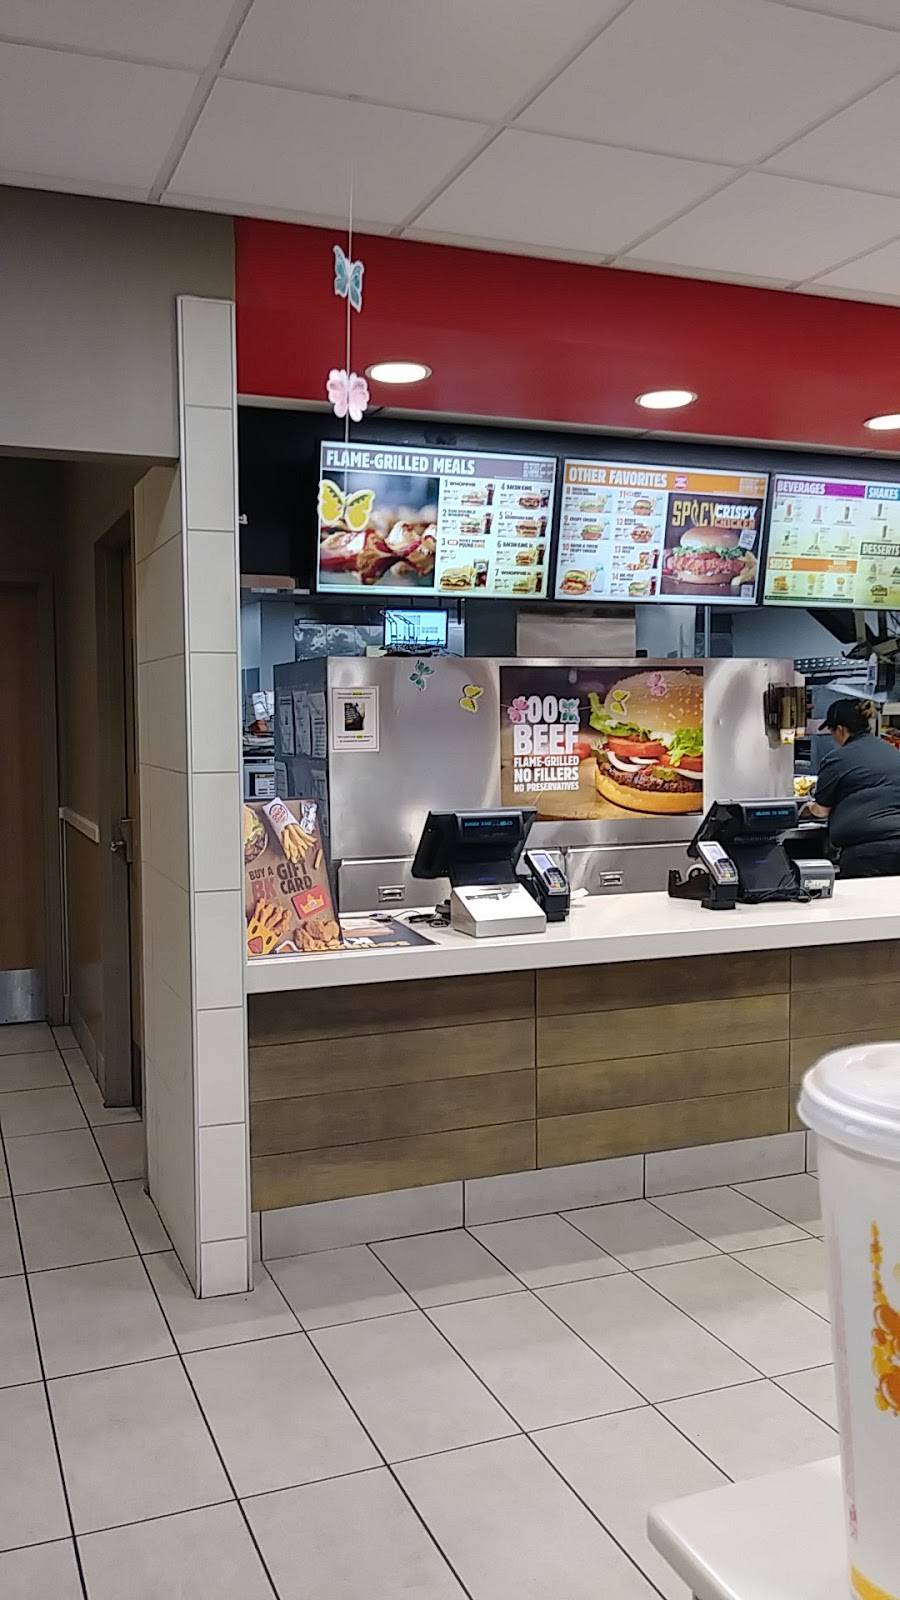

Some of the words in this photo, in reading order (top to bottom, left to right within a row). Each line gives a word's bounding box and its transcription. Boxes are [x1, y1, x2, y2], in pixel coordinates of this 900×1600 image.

[326, 450, 429, 472] FLAME-GRILLED
[433, 457, 475, 475] MEALS
[569, 466, 606, 483] OTHER
[608, 470, 668, 488] FAVORITES
[777, 480, 826, 495] BEVERAGES
[868, 487, 899, 499] SHAKES
[672, 500, 717, 528] SPICY
[715, 504, 758, 520] CRISPY
[714, 518, 756, 529] CHICKEN
[862, 543, 900, 555] DESSERTS
[769, 558, 793, 569] SIDES
[514, 724, 579, 755] BEEF
[514, 755, 580, 767] FLAME-GRILLED
[514, 768, 531, 783] NO
[534, 767, 579, 782] FILLERS
[514, 783, 525, 792] NO
[526, 781, 579, 792] PRESERVATIVES
[249, 868, 266, 881] BUY
[267, 865, 274, 876] A
[276, 860, 309, 880] GIFT
[252, 876, 277, 899] BK
[279, 875, 312, 895] CARD
